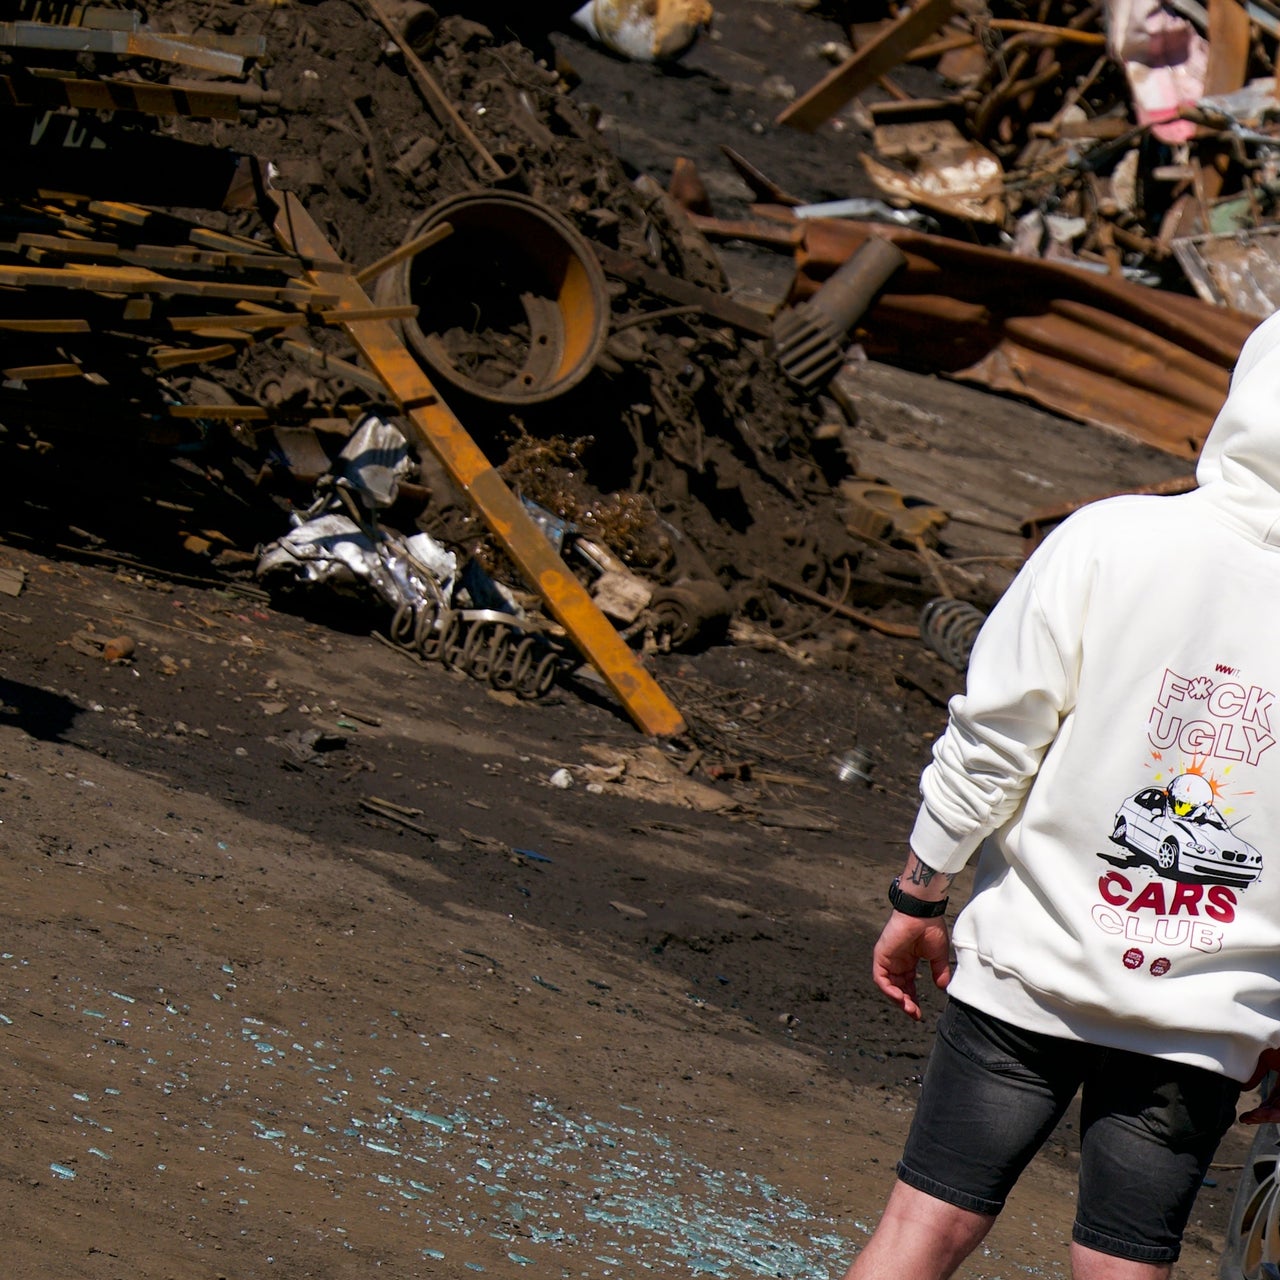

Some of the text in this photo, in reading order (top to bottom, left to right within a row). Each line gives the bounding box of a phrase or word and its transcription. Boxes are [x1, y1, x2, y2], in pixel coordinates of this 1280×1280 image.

[1148, 707, 1276, 767] UGLY
[1098, 870, 1237, 923] CARS
[1091, 904, 1223, 954] CLUB
